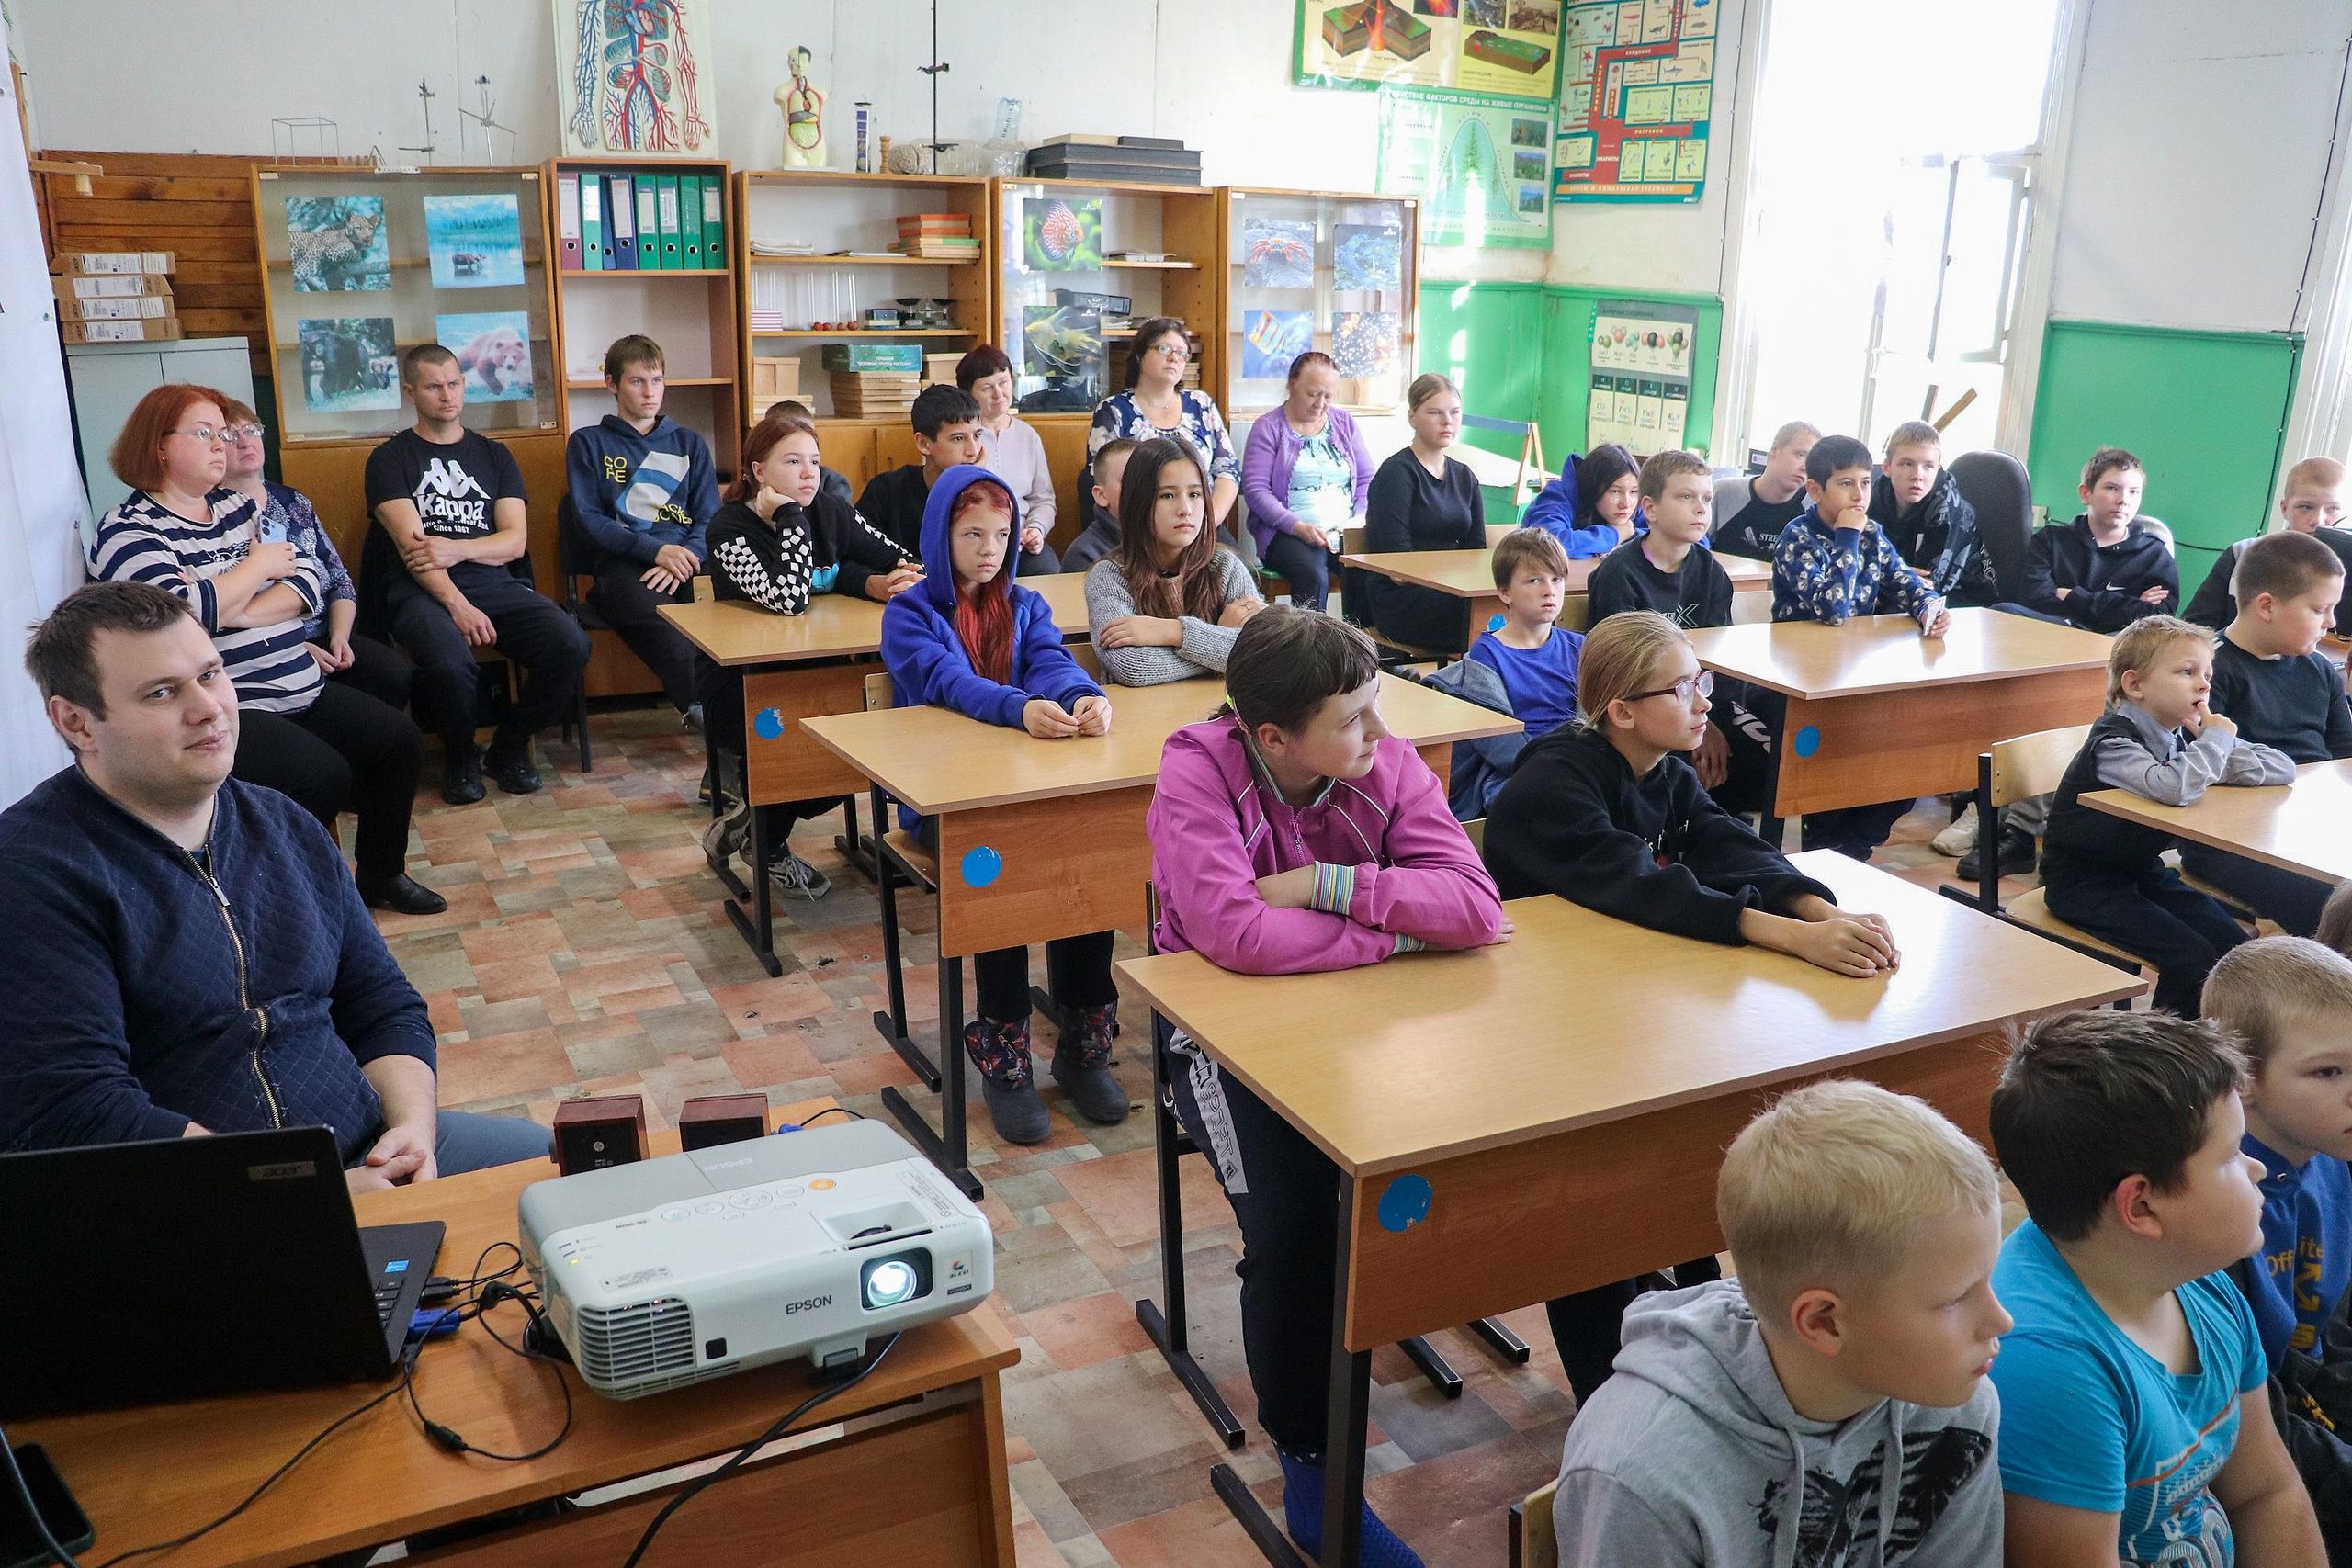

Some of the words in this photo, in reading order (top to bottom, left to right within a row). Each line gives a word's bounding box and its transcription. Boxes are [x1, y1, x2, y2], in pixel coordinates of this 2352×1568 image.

[1425, 94, 1458, 103] ФАКТОРОВ
[417, 492, 485, 523] Kappa
[433, 525, 453, 533] since
[1758, 533, 1780, 544] STRE
[703, 1156, 754, 1173] EPSON
[786, 1294, 832, 1315] EPSON
